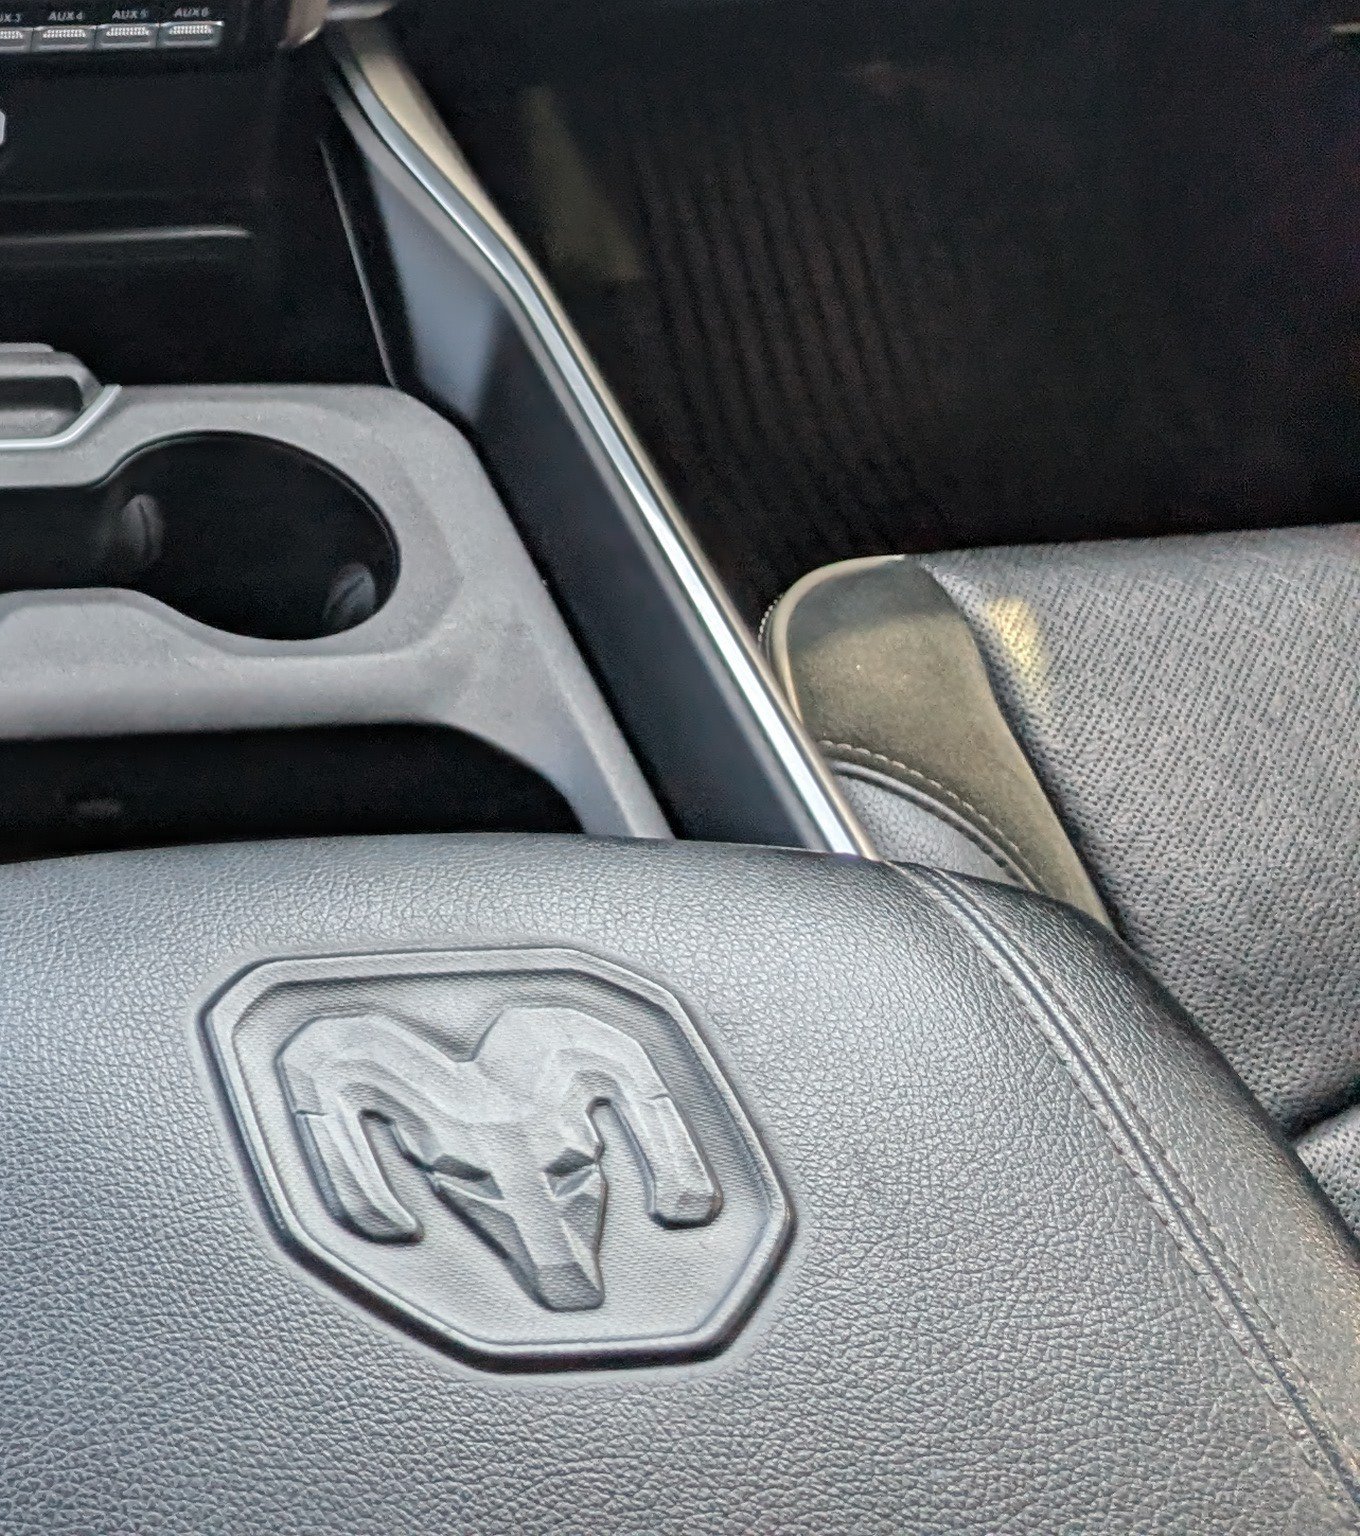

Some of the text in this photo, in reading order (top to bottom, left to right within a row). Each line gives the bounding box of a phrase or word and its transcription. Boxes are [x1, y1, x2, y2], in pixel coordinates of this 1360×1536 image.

[48, 12, 74, 21] AUX
[112, 10, 138, 19] AUX
[174, 8, 199, 17] AUX
